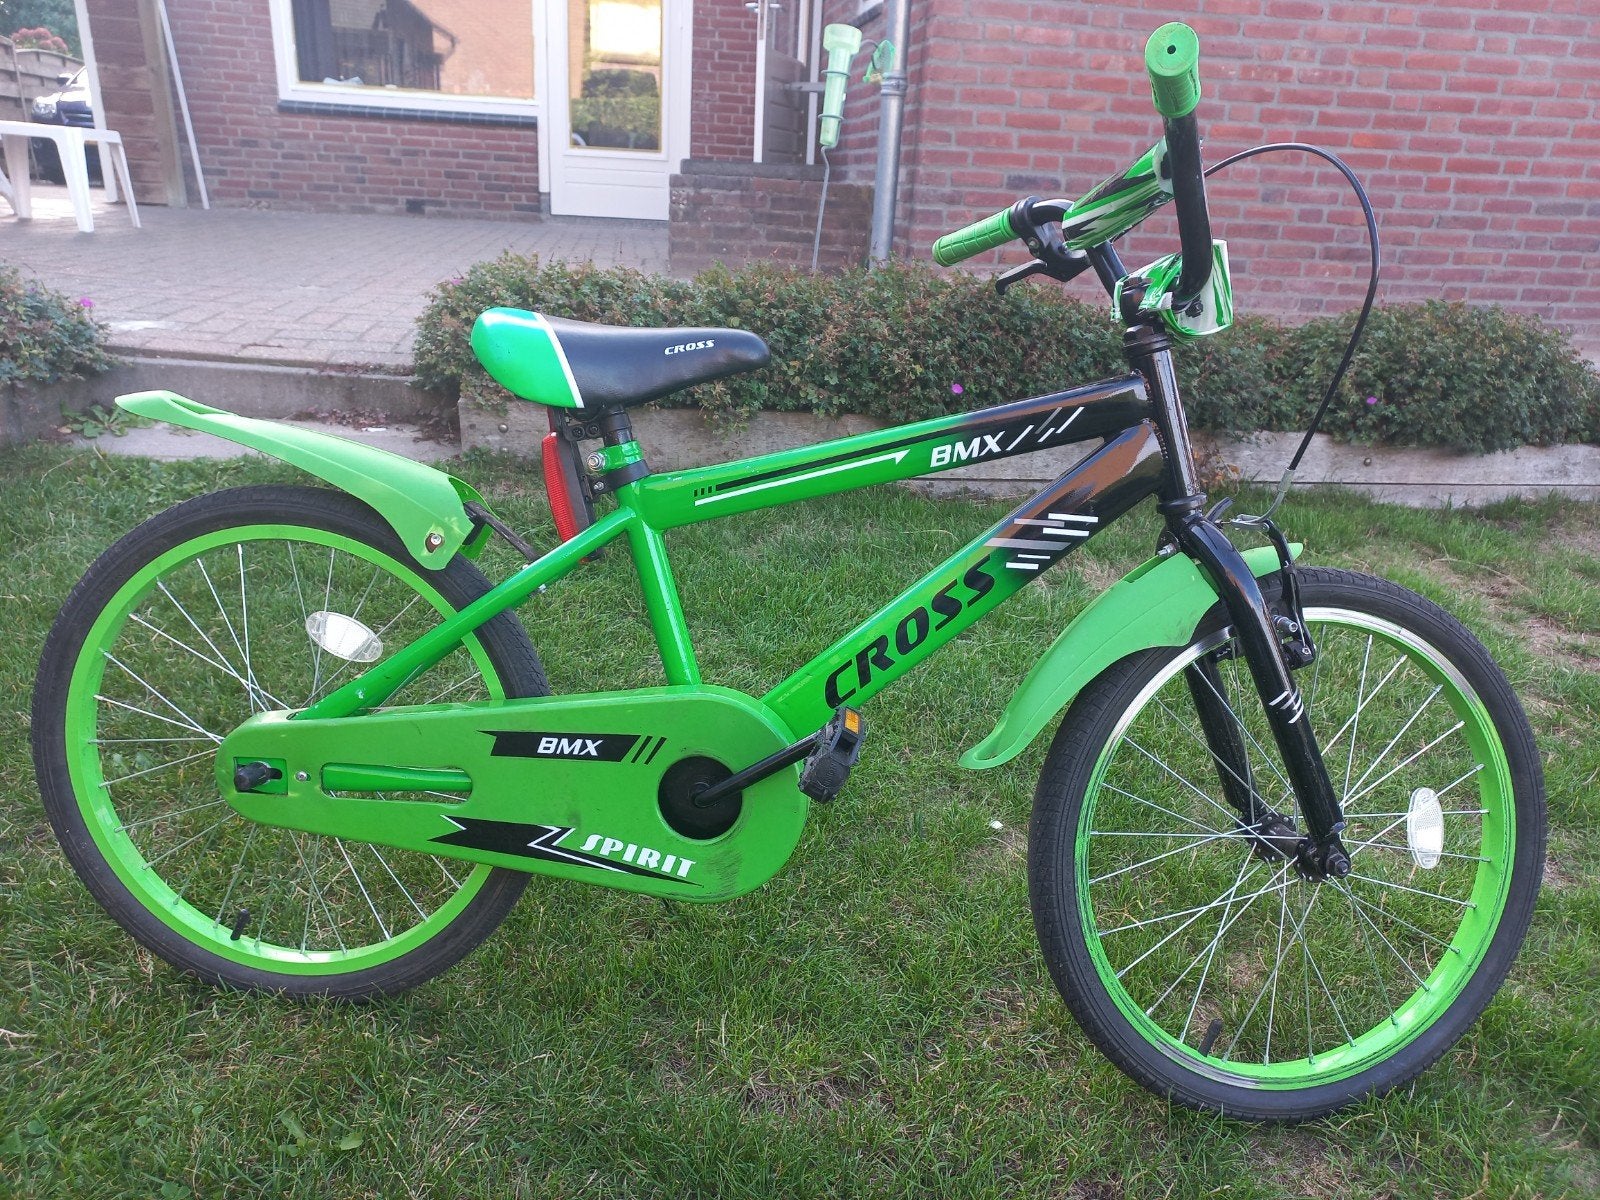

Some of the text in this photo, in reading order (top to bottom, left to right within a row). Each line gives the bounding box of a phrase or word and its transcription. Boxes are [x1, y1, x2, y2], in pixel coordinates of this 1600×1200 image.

[664, 339, 715, 356] CROSS
[930, 431, 1005, 468] BMX
[825, 556, 995, 709] CROSS
[536, 737, 603, 756] BMX
[580, 834, 696, 878] SPIRIT
